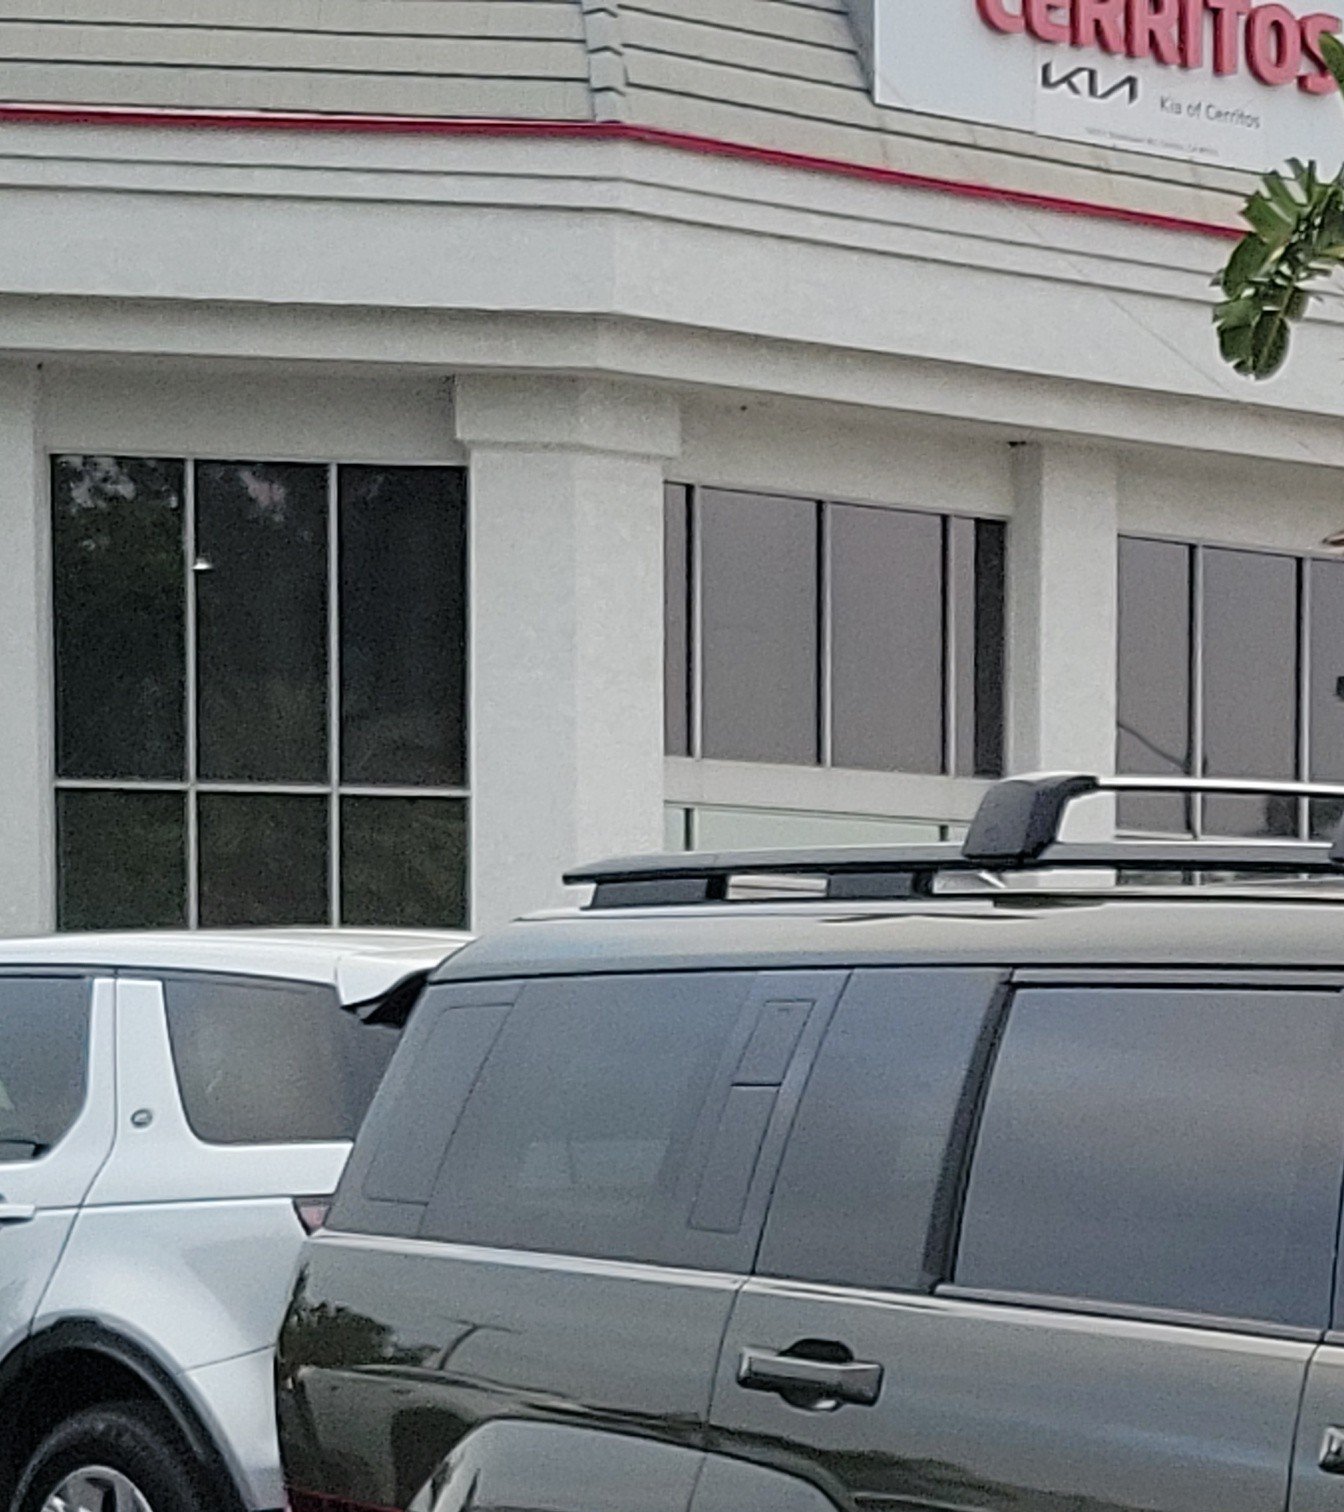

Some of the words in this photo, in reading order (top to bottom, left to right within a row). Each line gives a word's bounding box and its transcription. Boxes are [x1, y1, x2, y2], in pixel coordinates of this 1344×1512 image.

[1041, 61, 1138, 103] KIA
[1160, 96, 1182, 115] Kia
[1187, 102, 1202, 119] of
[1205, 103, 1261, 129] Cerritos
